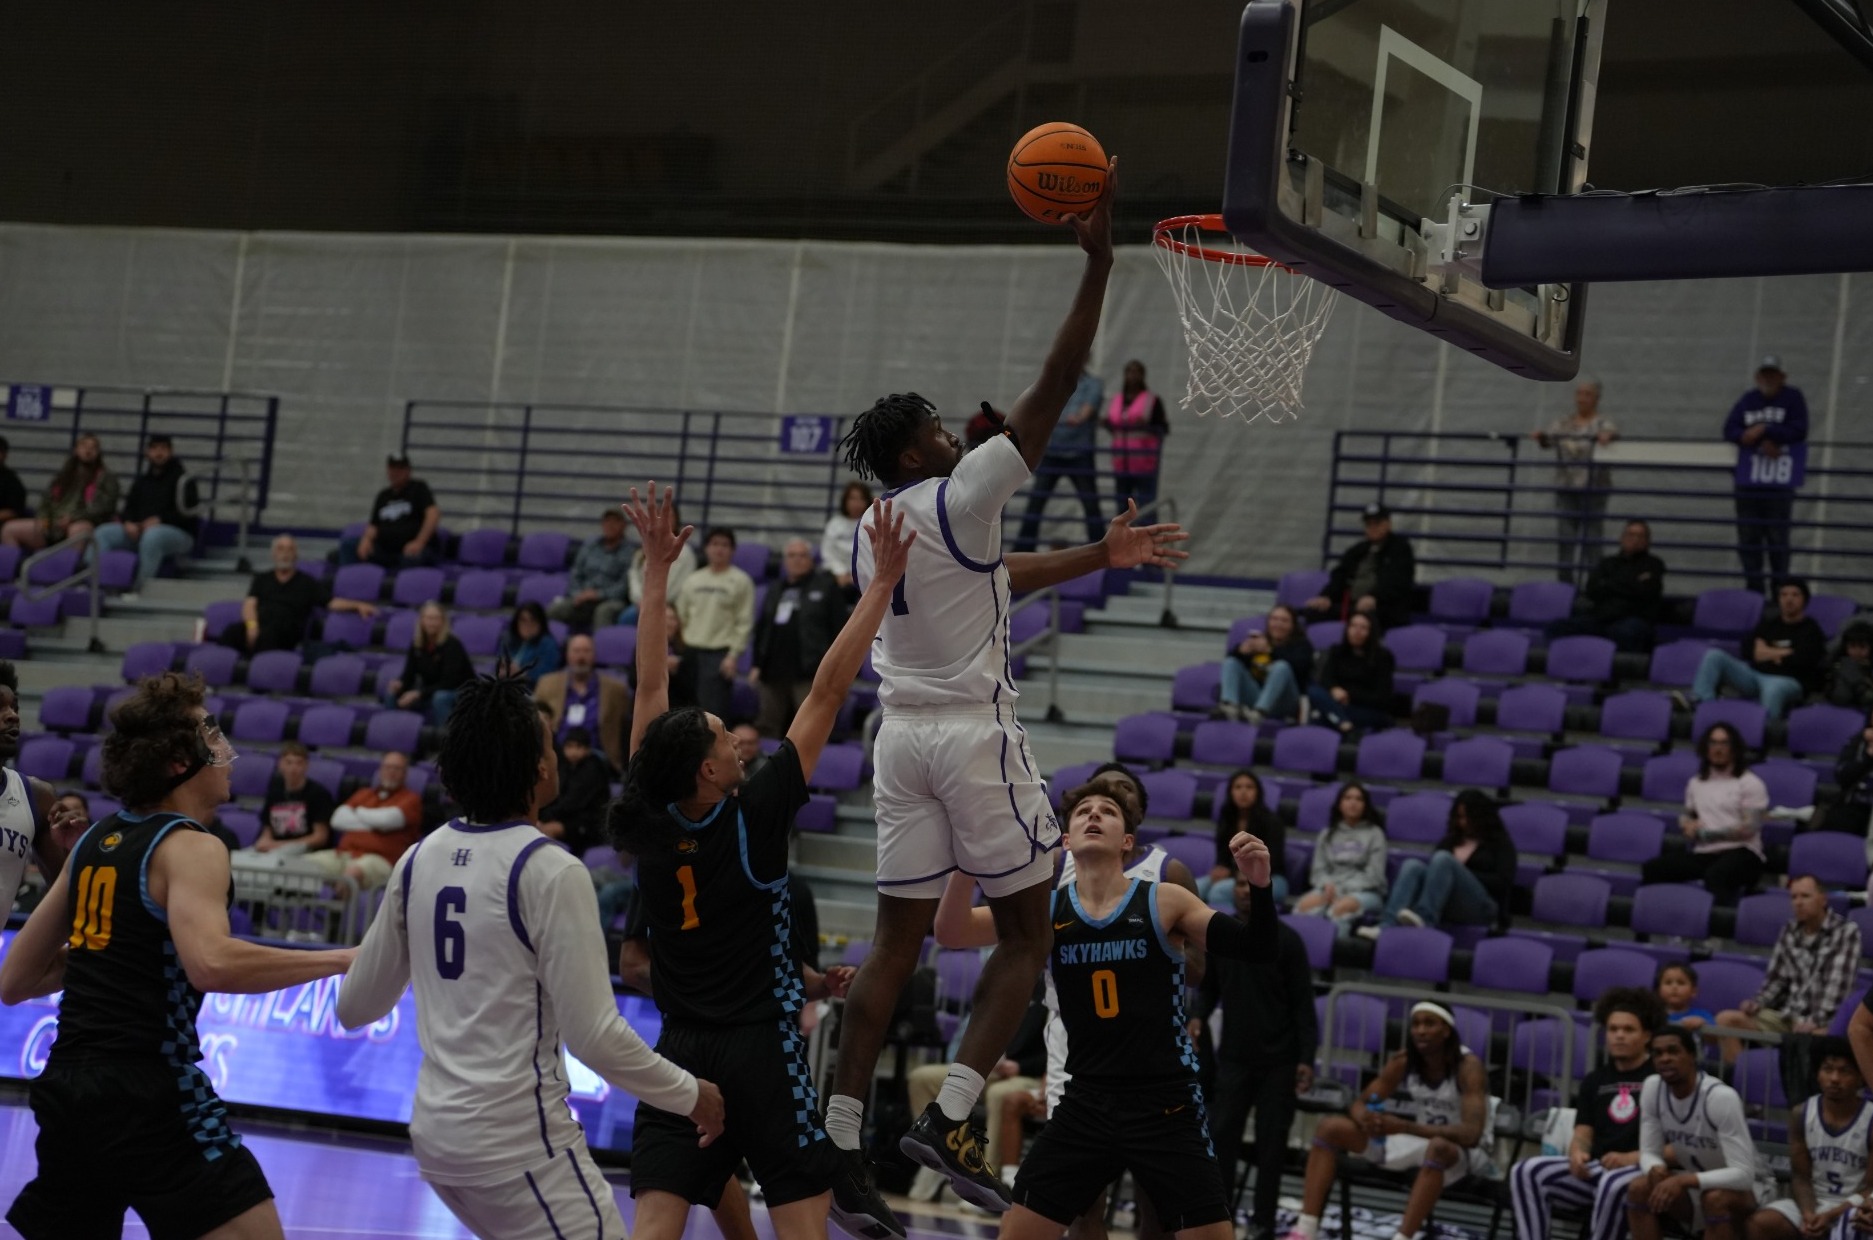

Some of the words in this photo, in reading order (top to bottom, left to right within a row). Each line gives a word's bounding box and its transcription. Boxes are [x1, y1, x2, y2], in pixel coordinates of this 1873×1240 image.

[1037, 172, 1100, 194] Wilson
[69, 865, 118, 950] 10
[675, 865, 700, 931] 1
[434, 886, 466, 980] 6
[1060, 938, 1148, 965] SKYHAWKS
[1091, 969, 1120, 1019] 0
[1827, 1172, 1843, 1193] 5
